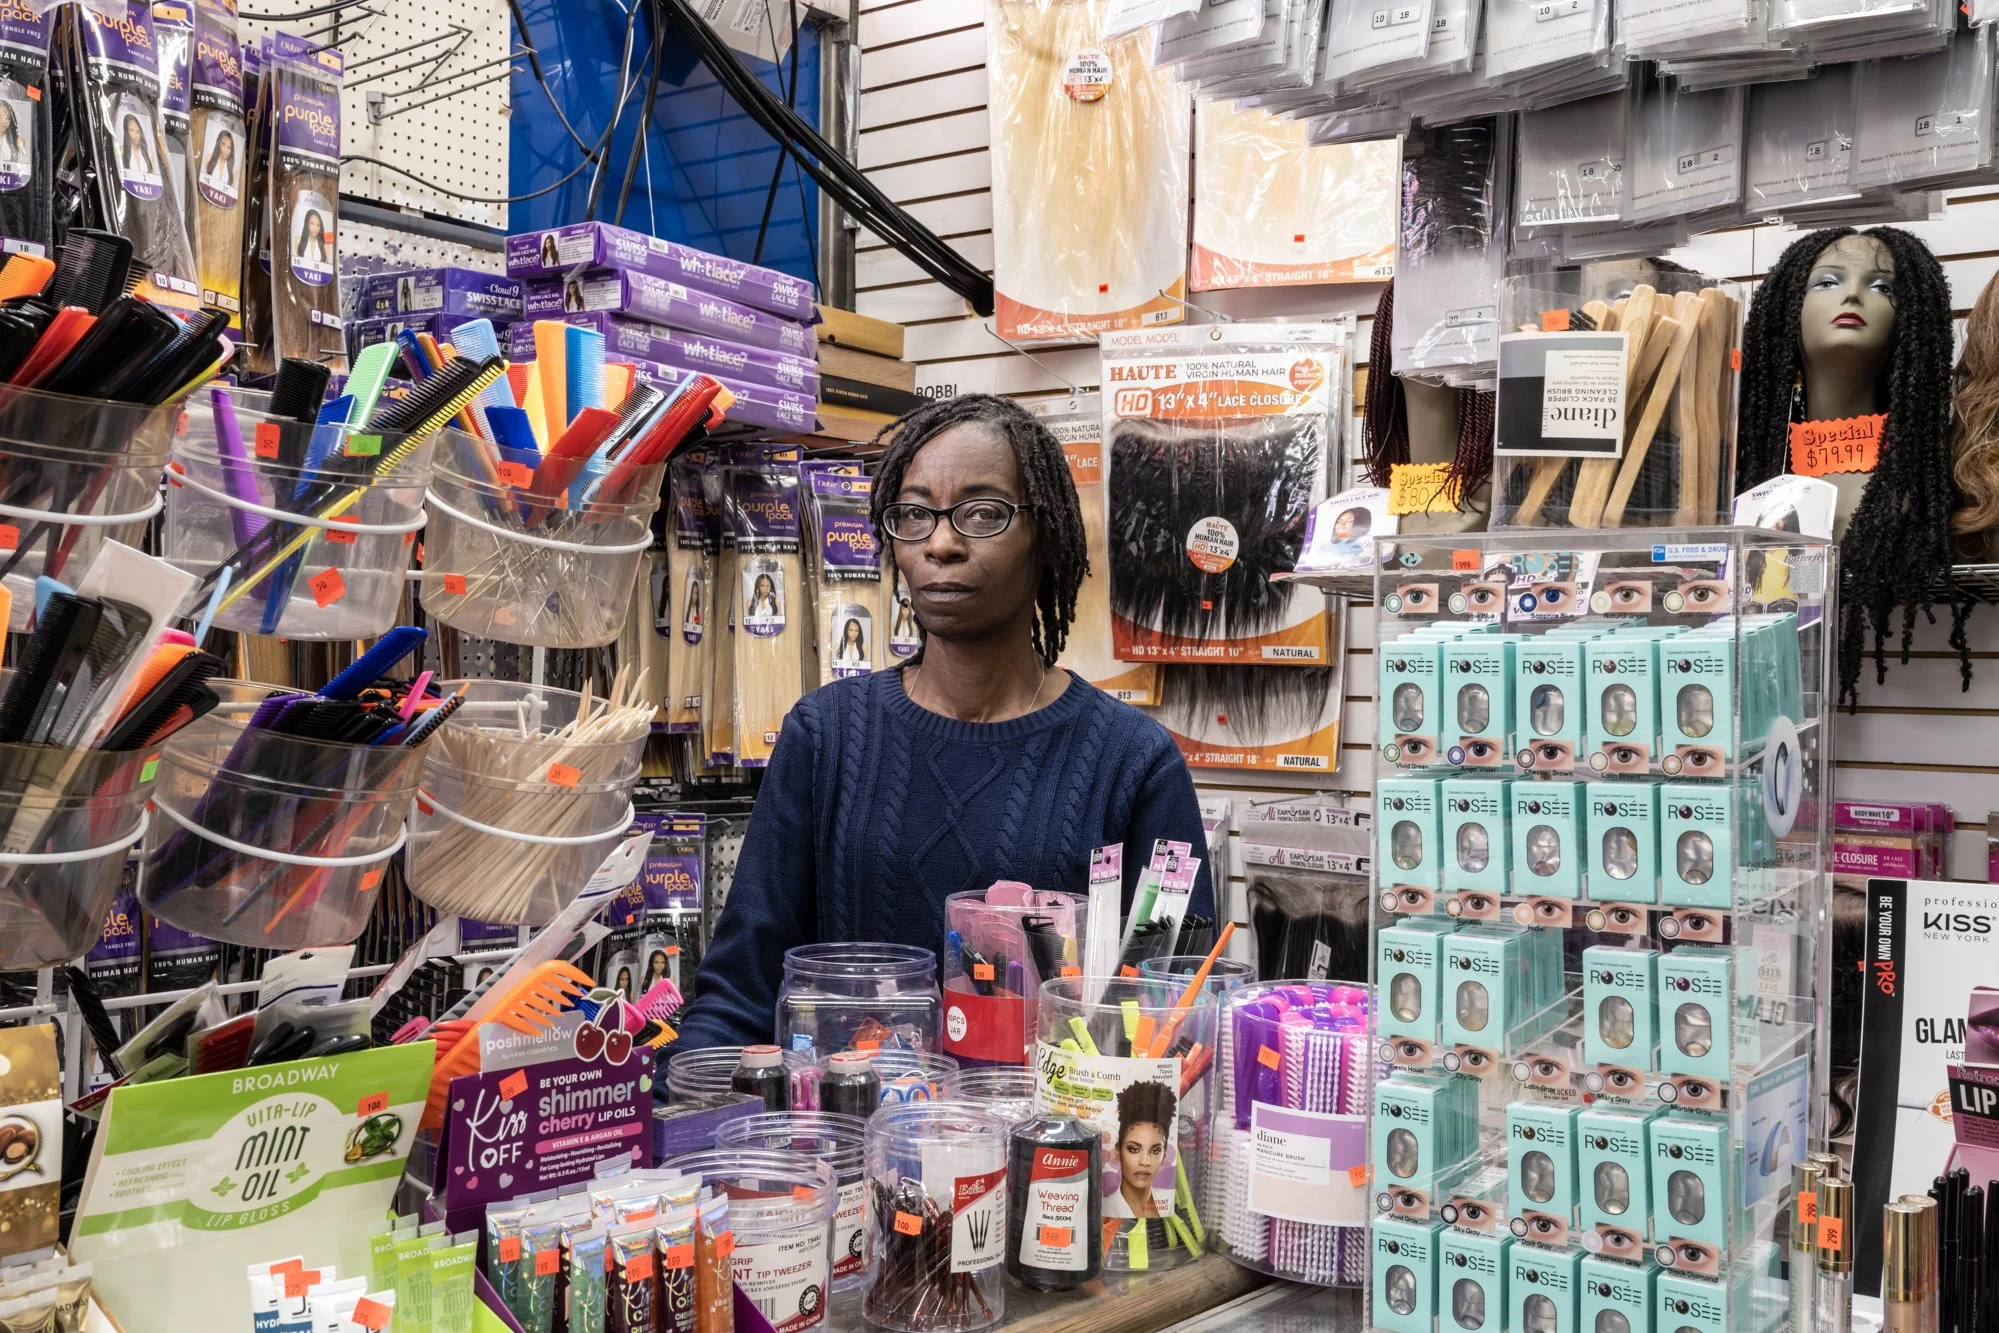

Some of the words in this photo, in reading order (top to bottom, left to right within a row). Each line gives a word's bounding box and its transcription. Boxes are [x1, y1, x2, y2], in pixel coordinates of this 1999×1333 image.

[1539, 7, 1550, 16] 10
[1572, 1, 1578, 9] 2
[1375, 14, 1385, 23] 10
[1399, 11, 1410, 20] 1B
[1436, 19, 1446, 28] 1B
[1, 25, 24, 33] TANGLE
[125, 34, 153, 49] pack
[21, 56, 41, 67] HAIR
[198, 41, 237, 69] purple
[285, 104, 333, 129] purple
[1919, 121, 1930, 130] 18
[1956, 116, 1962, 124] 1
[313, 122, 336, 138] pack
[1809, 147, 1820, 155] 18
[283, 155, 299, 165] 100%
[302, 159, 324, 170] HUMAN
[1681, 160, 1692, 169] 18
[1713, 153, 1719, 161] 2
[1583, 167, 1594, 176] 18
[133, 184, 152, 195] YAKI
[209, 188, 226, 204] YAKI
[20, 244, 29, 252] 1B
[158, 277, 166, 285] 10
[304, 271, 321, 282] YAKI
[1265, 270, 1313, 282] STRAIGHT
[772, 281, 799, 298] SWISS
[467, 292, 497, 306] SWISS
[1155, 312, 1168, 322] 613
[1111, 336, 1143, 346] MODEL
[1146, 333, 1179, 343] MODEL
[1186, 362, 1209, 370] 100%
[1212, 360, 1256, 369] NATURAL
[1186, 371, 1220, 379] VIRGIN
[1261, 368, 1285, 376] HAIR
[1121, 392, 1150, 412] HD
[1218, 394, 1246, 407] LACE
[1250, 392, 1302, 406] CLOSURE
[1551, 407, 1616, 429] diane
[1802, 421, 1874, 447] Special
[1077, 457, 1098, 468] LACE
[1807, 444, 1864, 470] $79.99
[768, 511, 794, 521] pack
[835, 521, 864, 529] premium
[827, 530, 871, 551] purple
[1195, 534, 1218, 544] HUMAN
[1218, 538, 1234, 547] HAIR
[1207, 529, 1225, 538] 100%
[852, 540, 875, 552] pack
[1132, 645, 1145, 656] HD
[1180, 645, 1225, 656] STRAIGHT
[1272, 648, 1314, 658] NATURAL
[1117, 691, 1131, 700] 613
[1205, 753, 1244, 764] STRAIGHT
[1284, 756, 1320, 766] NATURAL
[1663, 776, 1699, 785] Symphony
[1261, 806, 1276, 822] Ali
[1269, 849, 1285, 865] Ali
[1841, 852, 1878, 866] CLOSURE
[667, 882, 695, 895] pack
[1880, 896, 1892, 909] BE
[1924, 897, 1997, 909] professio
[1879, 910, 1892, 936] YOUR
[1924, 913, 1992, 933] KISS
[103, 920, 134, 942] pack
[1924, 933, 1952, 941] NEW
[1957, 933, 1989, 943] YORK
[1878, 938, 1891, 960] OWN
[154, 959, 173, 968] 100%
[176, 956, 203, 967] HUMAN
[205, 953, 219, 962] HAIR
[91, 969, 121, 979] HUMAN
[123, 966, 138, 974] HAIR
[1873, 960, 1894, 995] PRO
[486, 1026, 573, 1054] poshmellow
[1037, 1047, 1067, 1084] Edge
[232, 1063, 340, 1094] BROADWAY
[540, 1078, 551, 1089] BE
[553, 1074, 578, 1085] YOUR
[580, 1069, 602, 1082] OWN
[1069, 1067, 1090, 1077] Brush
[1097, 1071, 1121, 1081] Comb
[1456, 1073, 1467, 1081] City
[1468, 1075, 1483, 1083] Gray
[539, 1080, 635, 1117] shimmer
[1597, 1093, 1613, 1102] Misty
[1614, 1095, 1630, 1104] Gray
[1959, 1084, 1997, 1114] LIP
[1671, 1104, 1691, 1113] Marble
[1693, 1107, 1712, 1117] Gray
[539, 1111, 595, 1135] cherry
[598, 1112, 613, 1122] LIP
[614, 1106, 636, 1120] OILS
[466, 1089, 528, 1173] Kiss
[552, 1137, 579, 1149] VITAMIN
[590, 1131, 612, 1142] ARGAN
[613, 1129, 623, 1137] OIL
[1256, 1130, 1287, 1147] diane
[235, 1125, 311, 1172] MINT
[480, 1142, 523, 1169] OFF
[1256, 1148, 1284, 1159] MANICURE
[1286, 1153, 1305, 1161] BRUSH
[121, 1162, 156, 1176] COOLING
[157, 1158, 188, 1172] EFFECT
[241, 1169, 281, 1202] OIL
[1038, 1189, 1079, 1203] Weaving
[205, 1213, 233, 1227] LIP
[240, 1201, 291, 1224] GLOSS
[1041, 1201, 1075, 1213] Thread
[896, 1219, 909, 1230] 100
[1404, 1215, 1419, 1224] Gray
[1454, 1226, 1465, 1234] Sky
[1466, 1228, 1480, 1236] Gray
[1828, 1228, 1838, 1244] 299
[1536, 1241, 1552, 1250] Gray
[730, 1257, 754, 1266] GRIP
[958, 1256, 996, 1267] PROFESSIONAL
[756, 1270, 772, 1278] TIP
[773, 1260, 812, 1278] TWEEZER
[1668, 1268, 1686, 1276] Black
[1686, 1271, 1719, 1284] Diamond
[806, 1313, 821, 1327] CHINA
